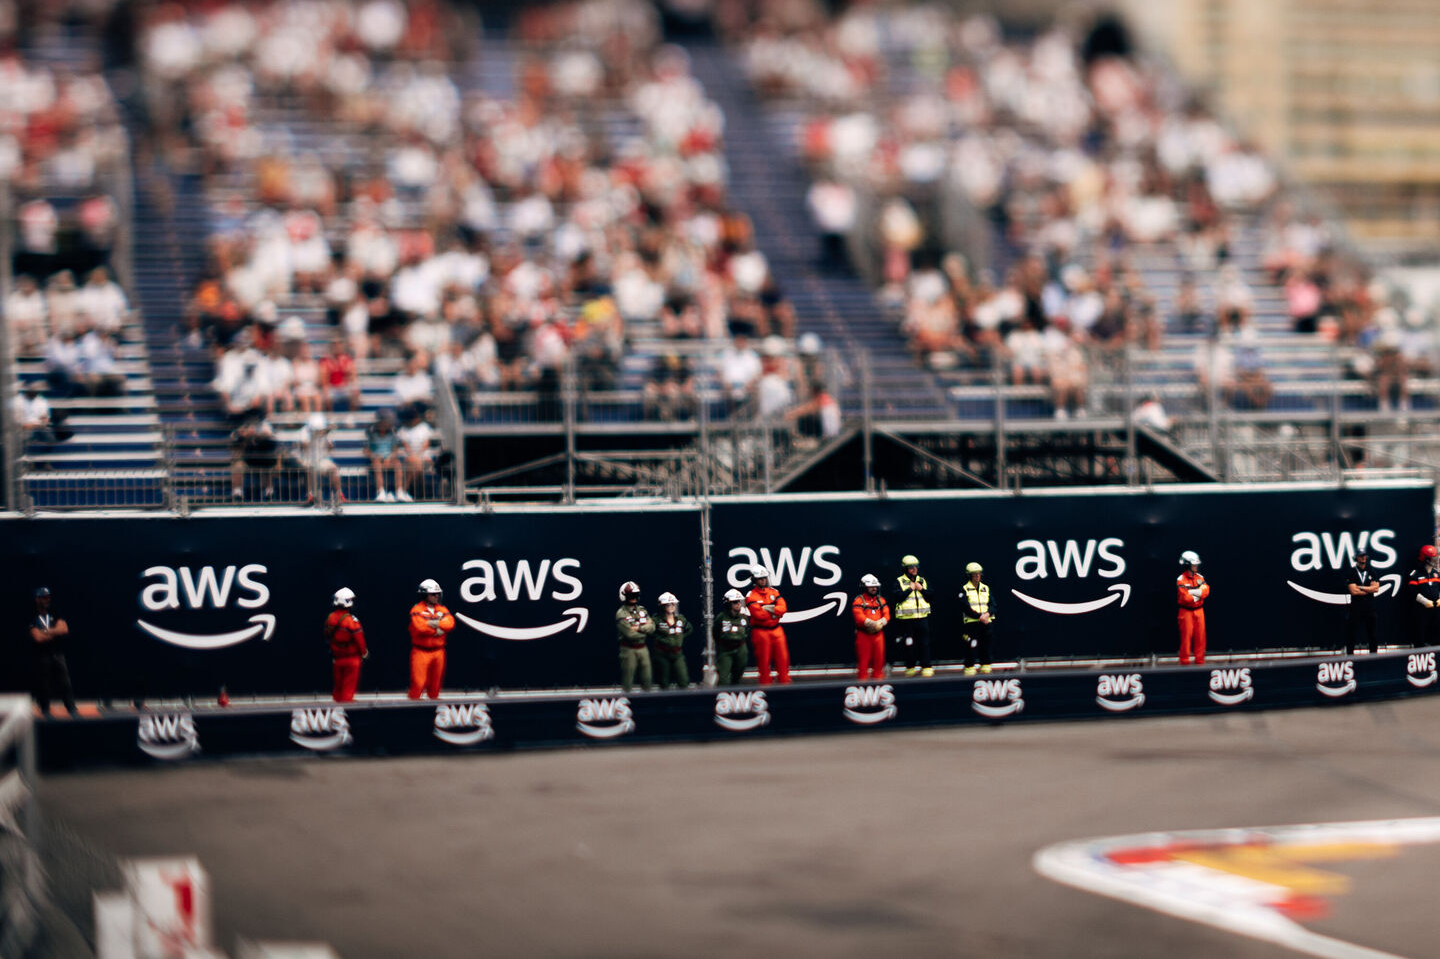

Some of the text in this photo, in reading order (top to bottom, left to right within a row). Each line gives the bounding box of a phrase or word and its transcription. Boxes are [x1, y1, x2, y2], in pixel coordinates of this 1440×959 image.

[1016, 538, 1125, 580] aws
[1291, 529, 1397, 571] aws
[726, 545, 842, 588] aws
[142, 564, 270, 610] aws
[461, 558, 582, 602] aws
[1318, 661, 1354, 682] aws
[1408, 653, 1436, 673] aws
[973, 678, 1022, 702] aws
[1097, 673, 1143, 696] aws
[1209, 668, 1252, 689] aws
[715, 690, 768, 715] aws
[844, 684, 896, 707] aws
[291, 707, 349, 733] aws
[435, 703, 491, 728] aws
[577, 697, 632, 722] aws
[139, 713, 195, 741] aws
